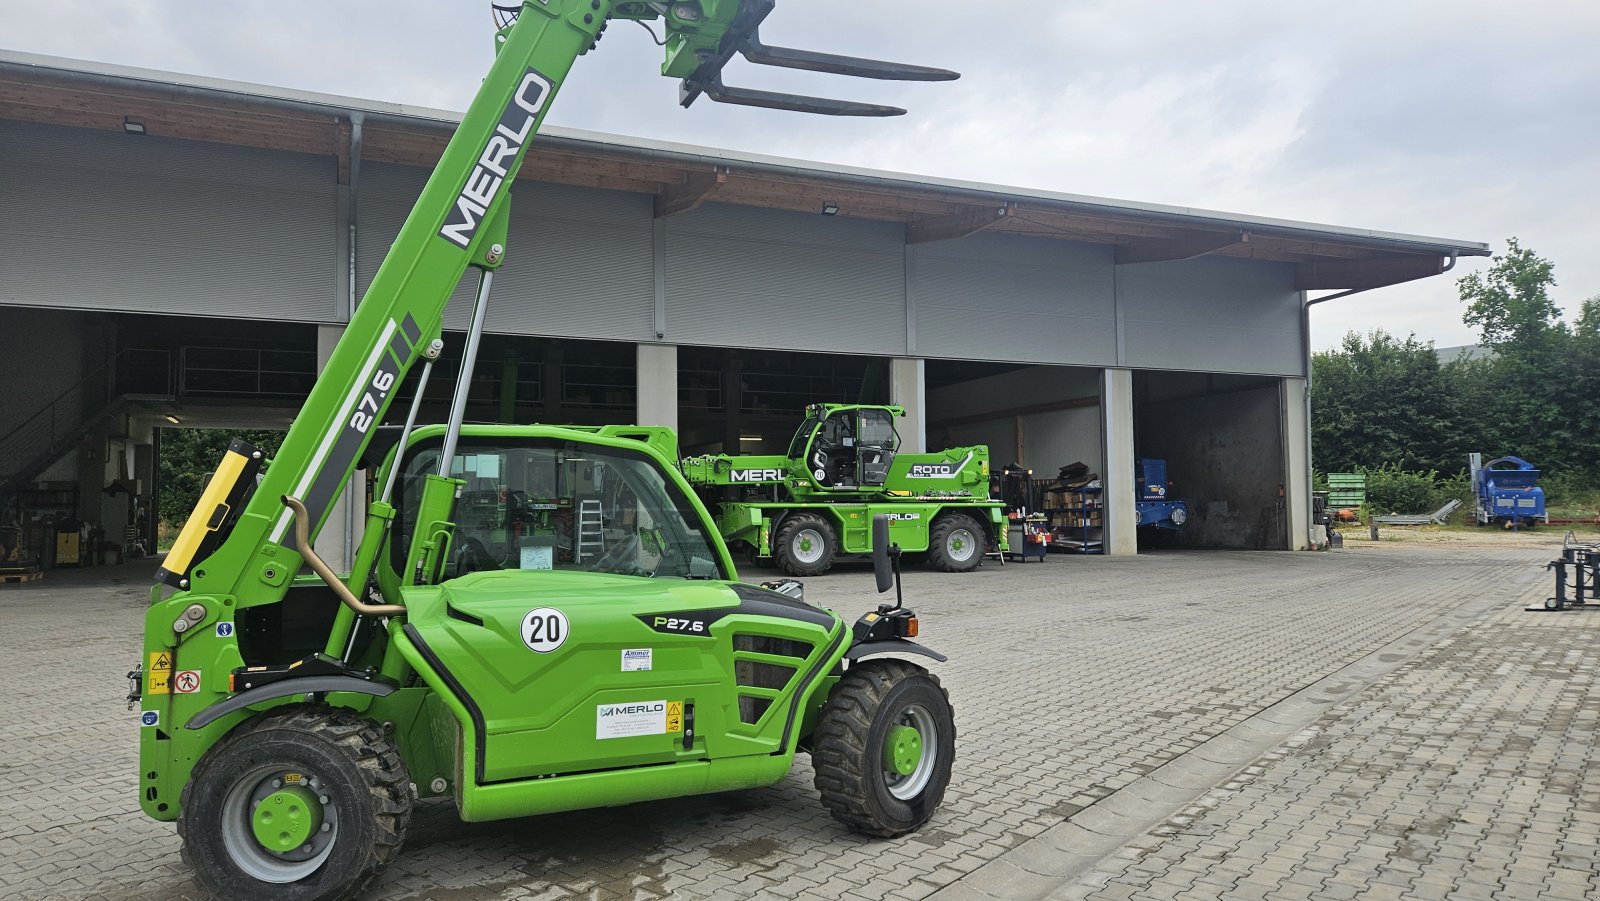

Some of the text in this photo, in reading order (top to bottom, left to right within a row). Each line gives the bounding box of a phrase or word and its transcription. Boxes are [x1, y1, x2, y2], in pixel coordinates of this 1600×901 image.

[441, 73, 551, 246] MERLO
[350, 369, 394, 434] 27.6
[731, 469, 788, 482] MERL
[913, 465, 950, 474] ROTO
[530, 615, 560, 643] 20
[654, 616, 704, 632] P27.6
[615, 704, 664, 715] MERLO
